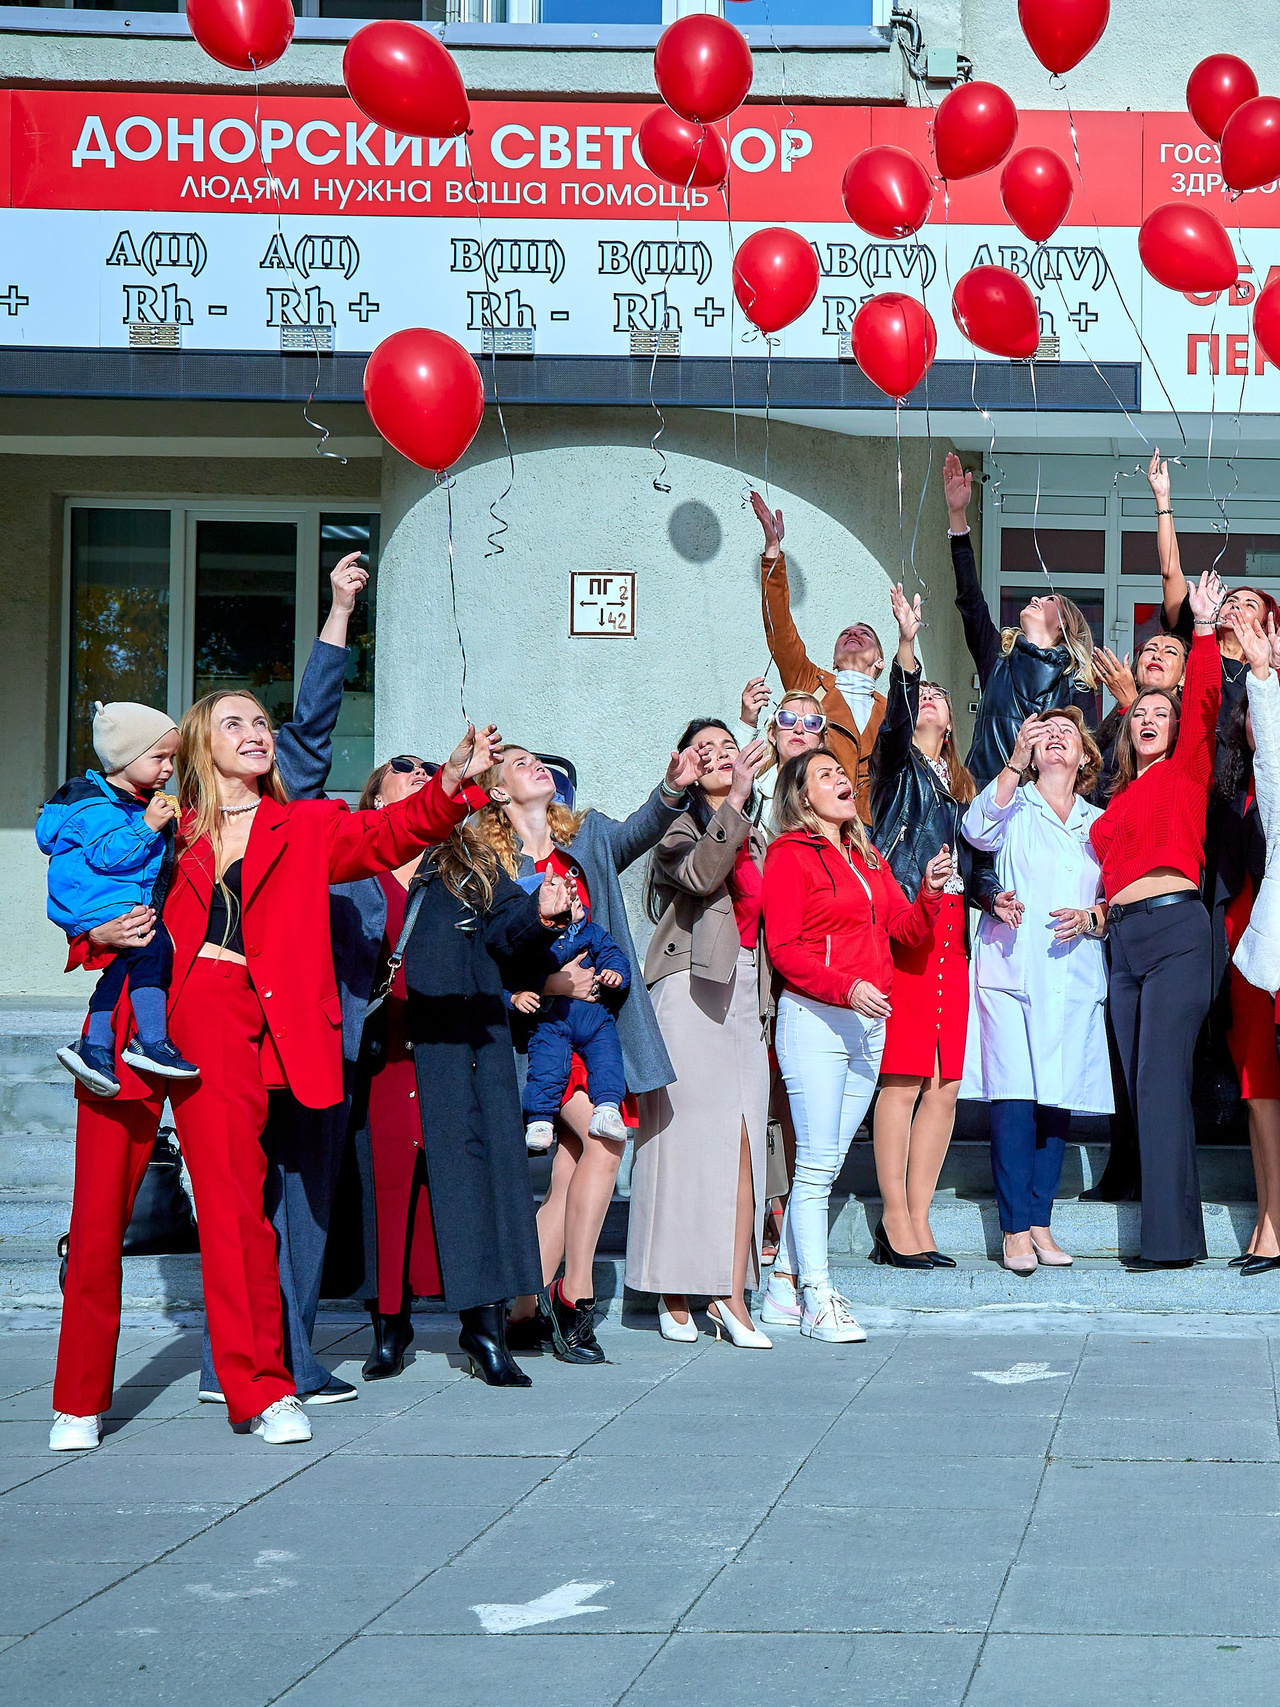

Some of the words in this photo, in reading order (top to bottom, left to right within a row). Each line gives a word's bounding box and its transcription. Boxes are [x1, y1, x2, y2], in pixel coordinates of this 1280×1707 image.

[490, 123, 813, 173] СВЕТОР
[314, 178, 431, 210] нужна
[445, 180, 547, 204] ваша
[561, 182, 709, 211] помощь
[123, 283, 193, 325] Rh
[266, 285, 337, 327] Rh
[348, 292, 380, 322] +
[467, 289, 537, 331] Rh
[613, 290, 683, 333] Rh
[694, 297, 726, 327] +
[1068, 302, 1098, 332] +
[589, 578, 614, 596] ПГ
[607, 611, 628, 631] 42
